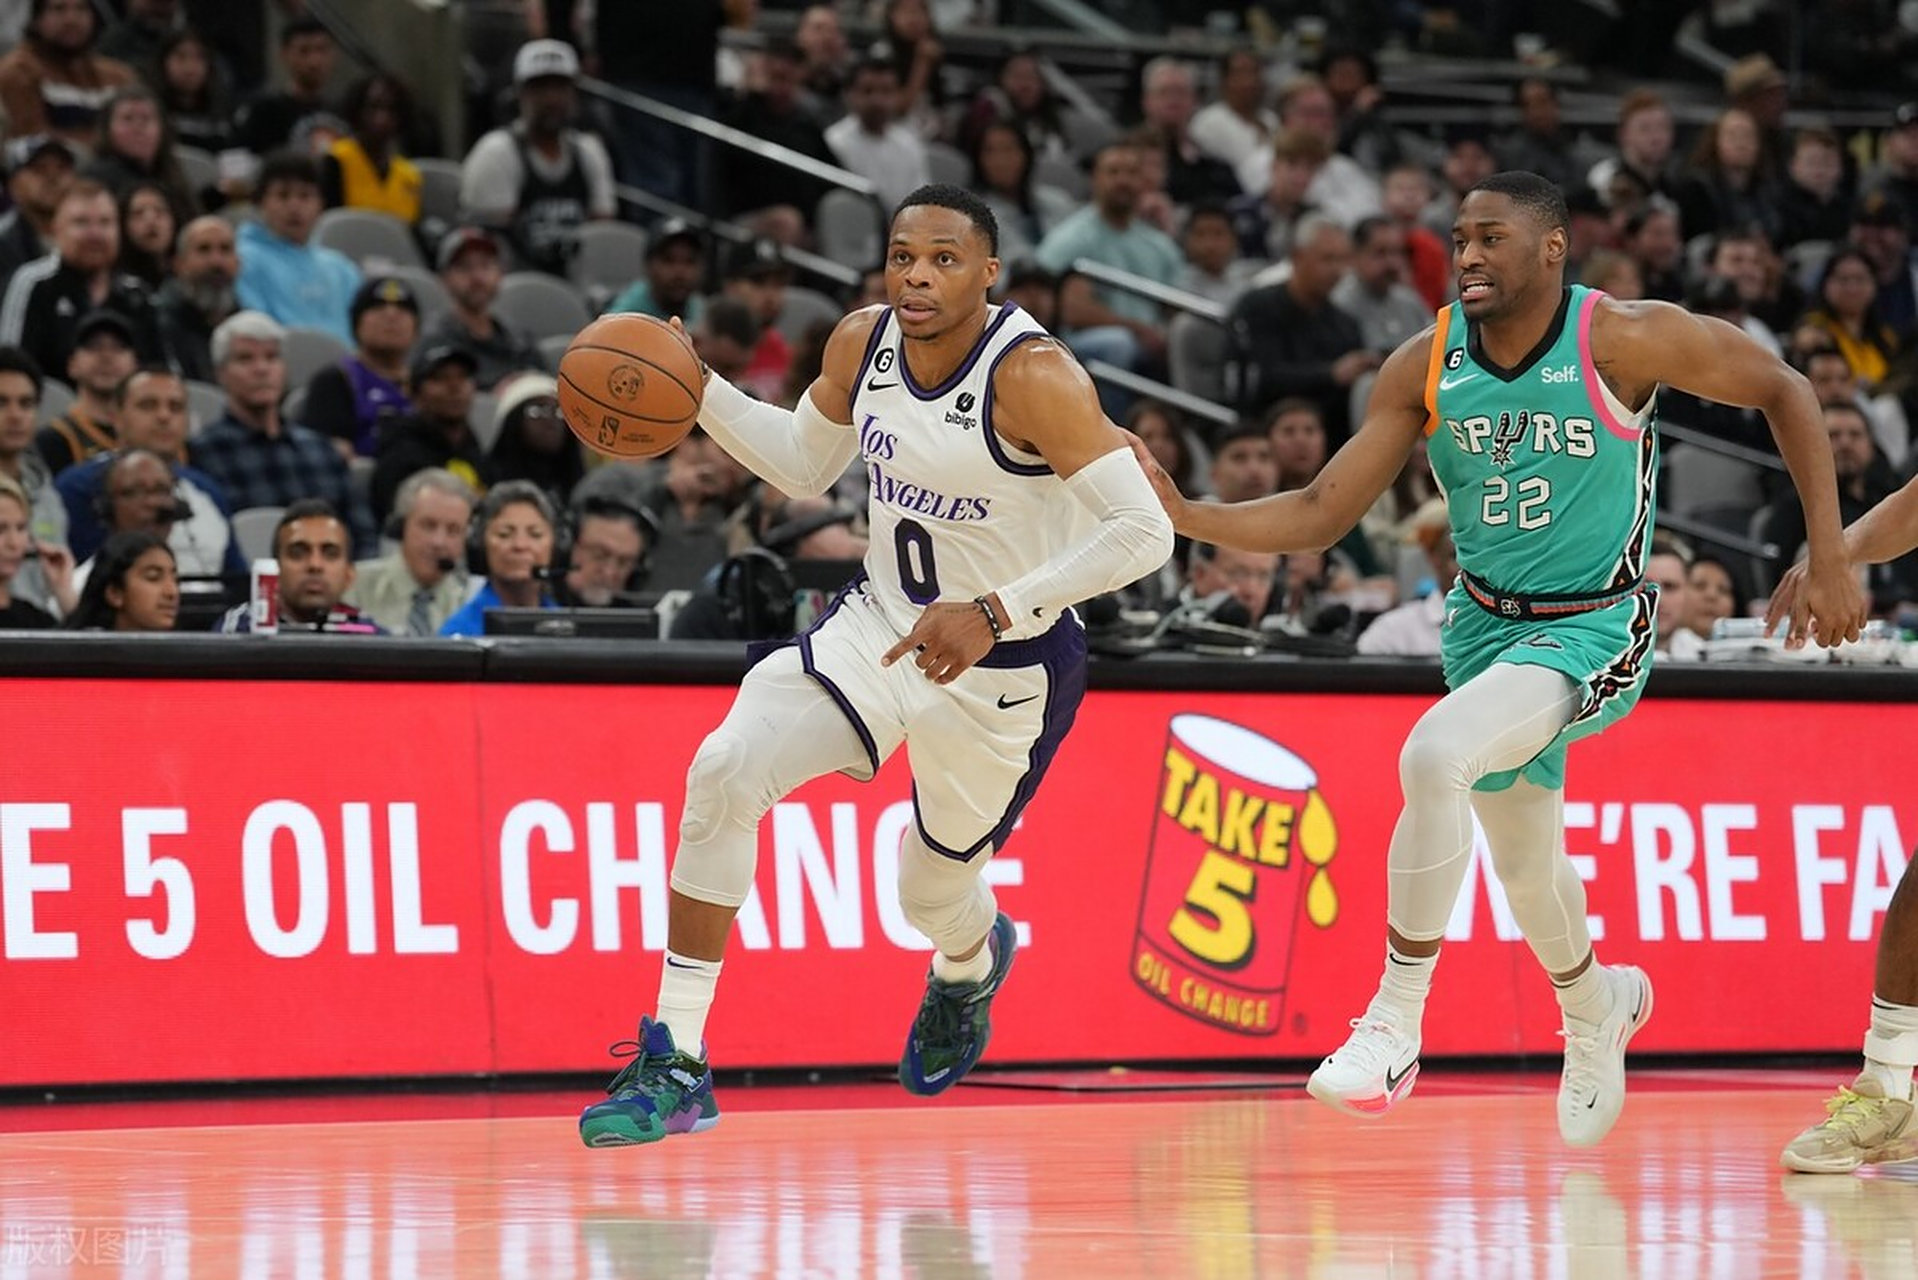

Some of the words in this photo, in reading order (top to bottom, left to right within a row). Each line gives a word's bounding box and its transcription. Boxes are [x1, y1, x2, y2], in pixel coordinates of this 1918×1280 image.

[878, 352, 892, 370] 6
[1449, 350, 1462, 368] 6
[1541, 366, 1579, 384] Self.
[944, 411, 978, 431] bibigo
[1445, 409, 1598, 470] SPURS
[870, 462, 992, 521] ANGELES
[1481, 475, 1552, 532] 22
[894, 517, 941, 605] 0
[1161, 747, 1295, 869] TAKE
[121, 806, 196, 961] 5
[241, 799, 459, 959] OIL
[499, 799, 1032, 955] CHN
[1168, 849, 1256, 972] 5
[1137, 951, 1171, 996] OIL
[1179, 977, 1271, 1030] CHANGE
